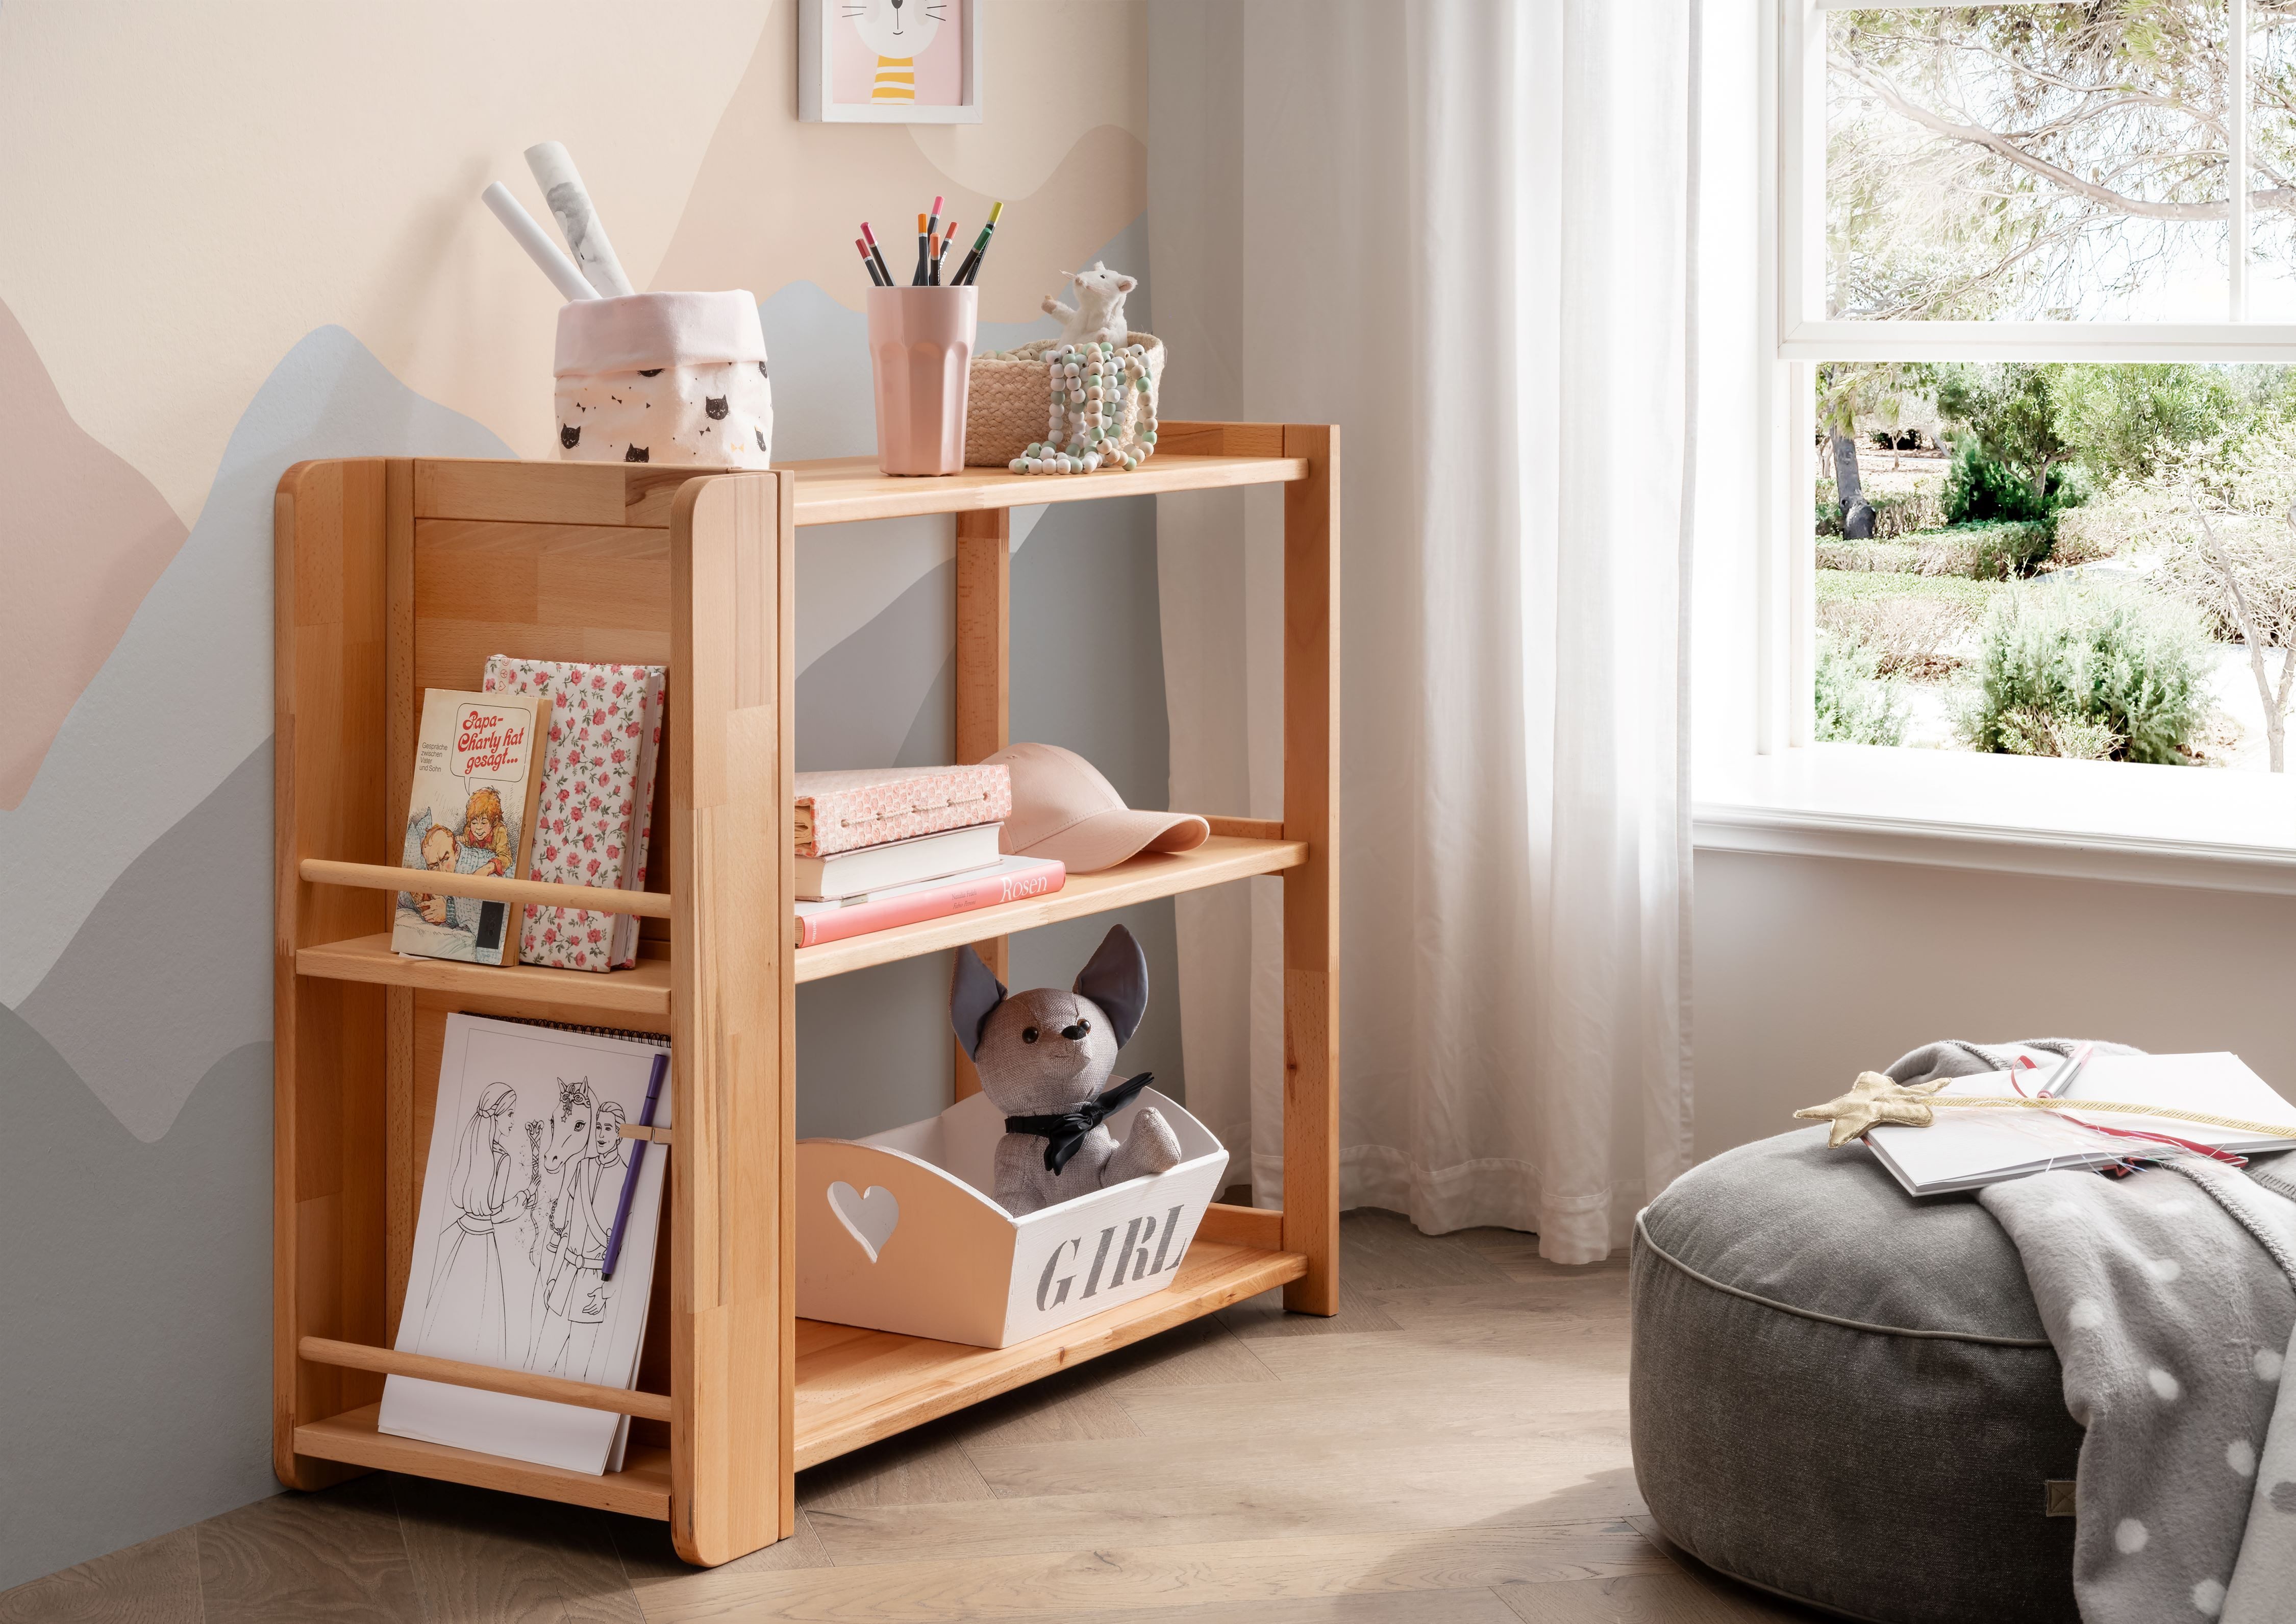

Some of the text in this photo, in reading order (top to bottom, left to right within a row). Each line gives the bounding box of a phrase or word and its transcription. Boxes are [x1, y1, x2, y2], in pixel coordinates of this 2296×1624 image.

[463, 710, 504, 734] Papa-
[422, 742, 448, 751] Gespräche
[458, 727, 525, 754] Charly hat
[465, 747, 518, 775] gesagt...
[1000, 876, 1047, 903] Rosen
[1036, 1204, 1187, 1311] GIRL
